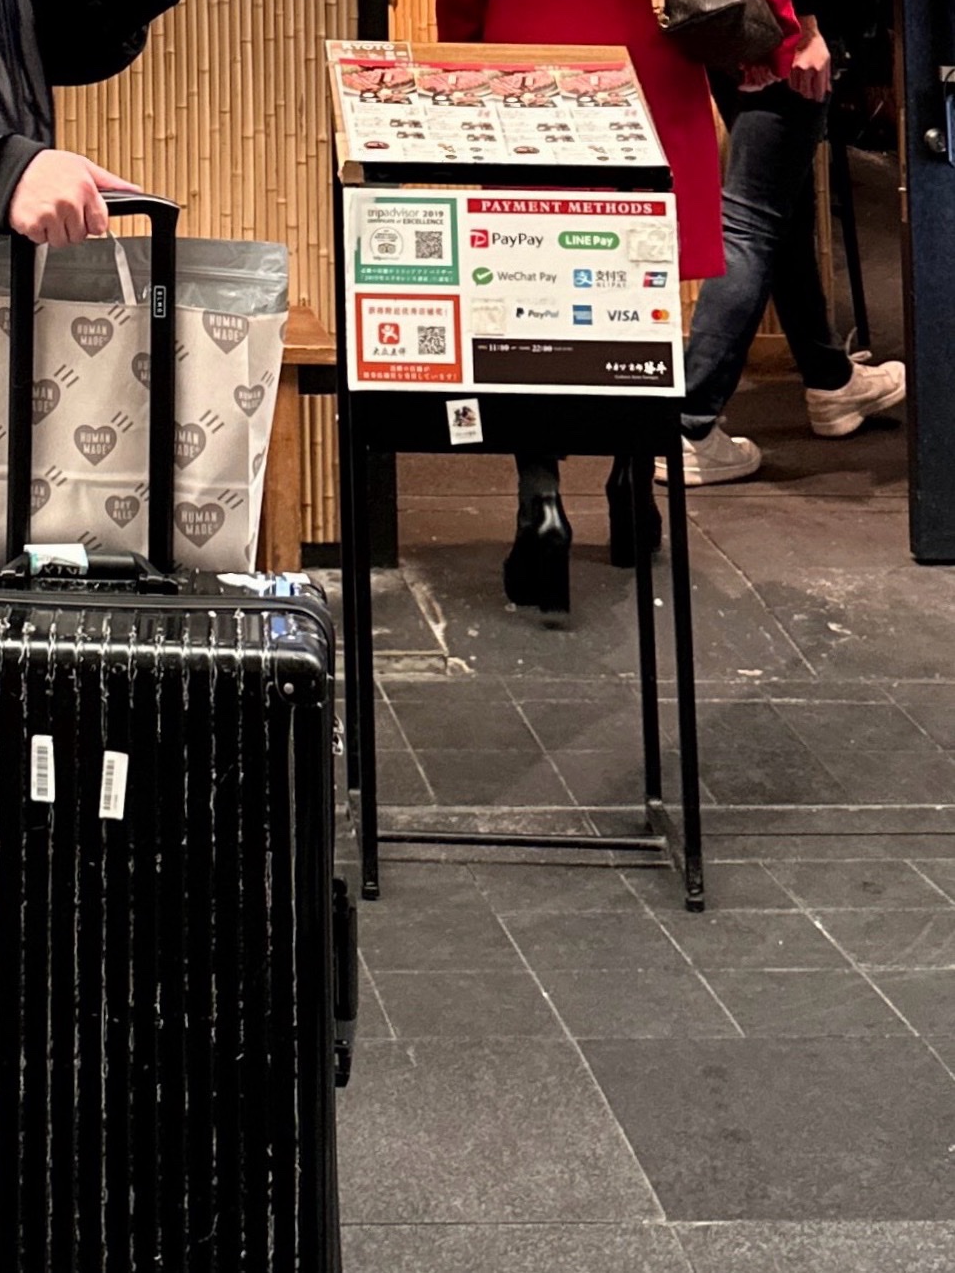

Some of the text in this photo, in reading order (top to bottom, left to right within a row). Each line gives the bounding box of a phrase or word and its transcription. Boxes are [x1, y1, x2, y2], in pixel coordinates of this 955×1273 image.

[367, 207, 419, 219] tripadvisor
[481, 200, 653, 214] PAYMENT METHODS
[492, 232, 544, 248] PayPay
[565, 234, 614, 247] LINE Pay
[497, 271, 557, 284] WeChat Pay
[209, 313, 244, 330] HUMAN
[606, 310, 640, 322] VISA
[76, 323, 108, 336] HUMAN
[79, 431, 111, 444] HUMAN
[181, 510, 218, 524] HUMAN
